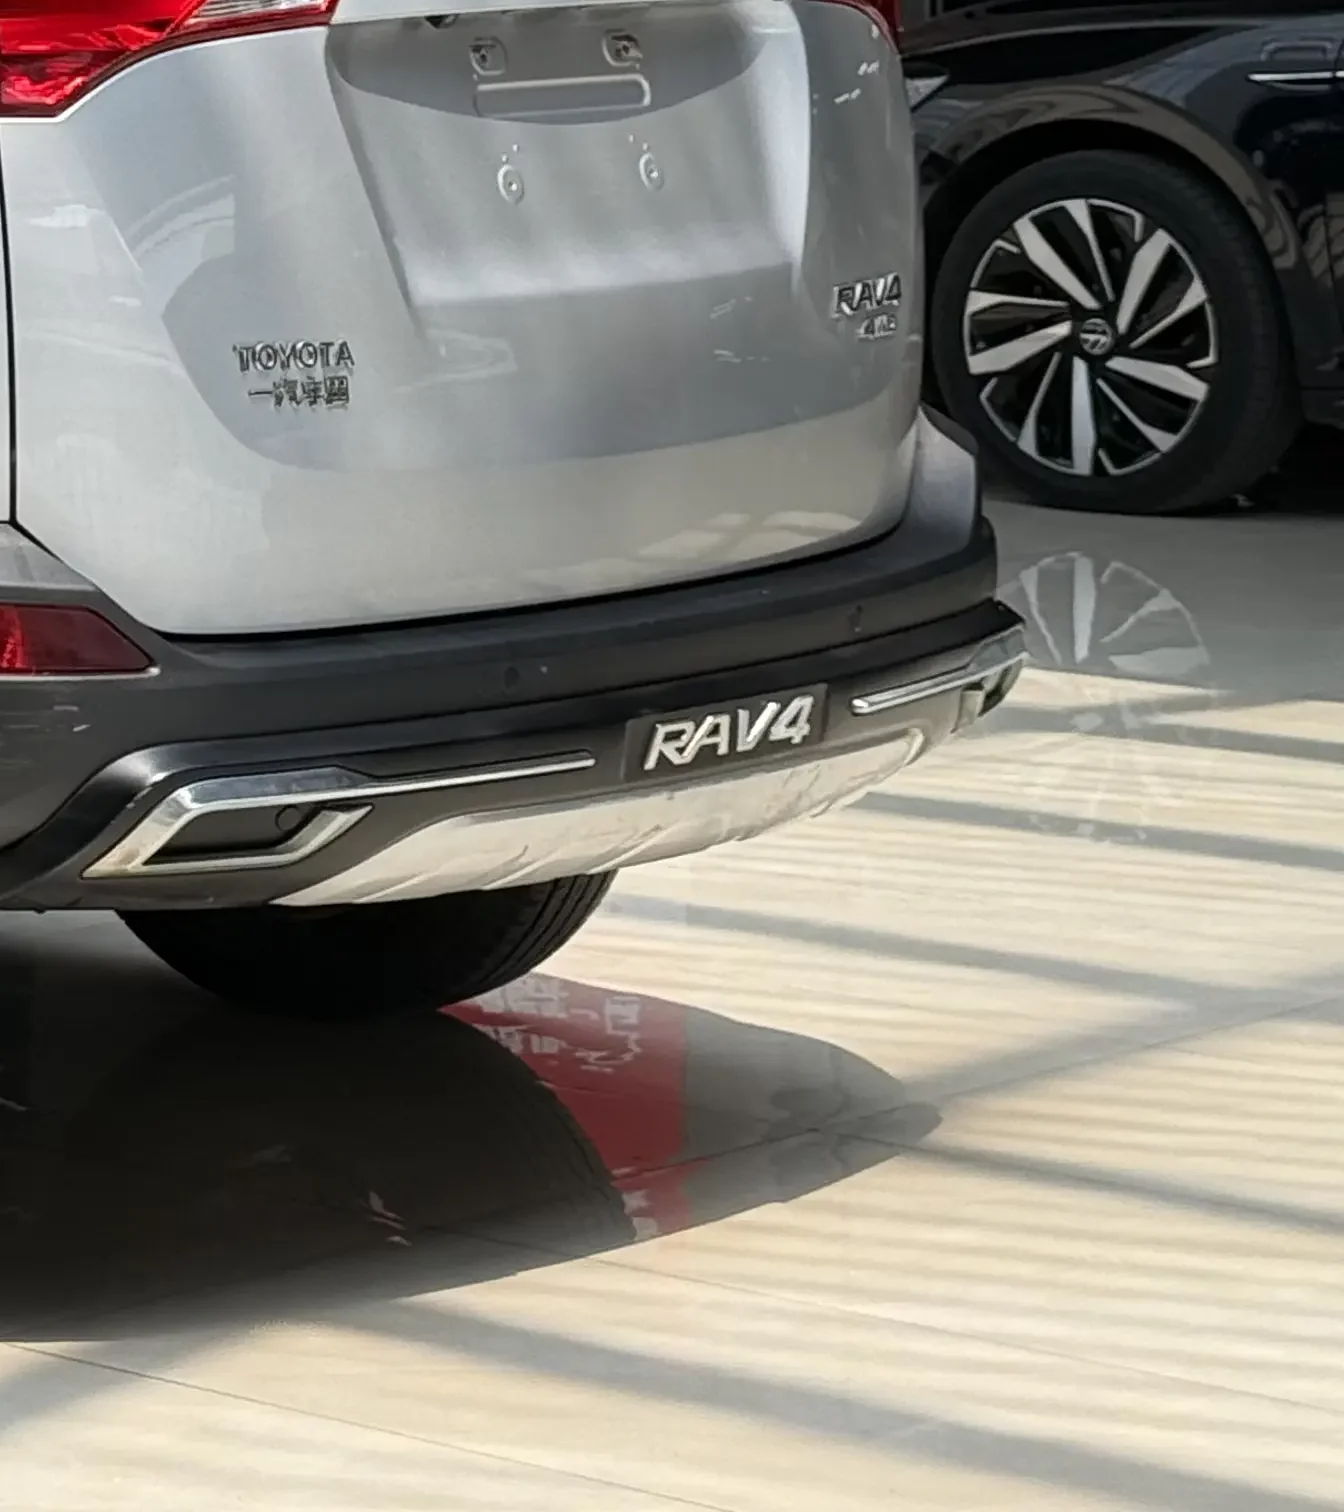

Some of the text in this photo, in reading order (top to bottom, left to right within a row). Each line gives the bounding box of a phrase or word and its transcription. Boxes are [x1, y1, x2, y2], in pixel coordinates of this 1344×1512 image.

[831, 272, 902, 317] RAV4
[232, 340, 356, 373] TOYOTA
[642, 694, 815, 772] RAV4
